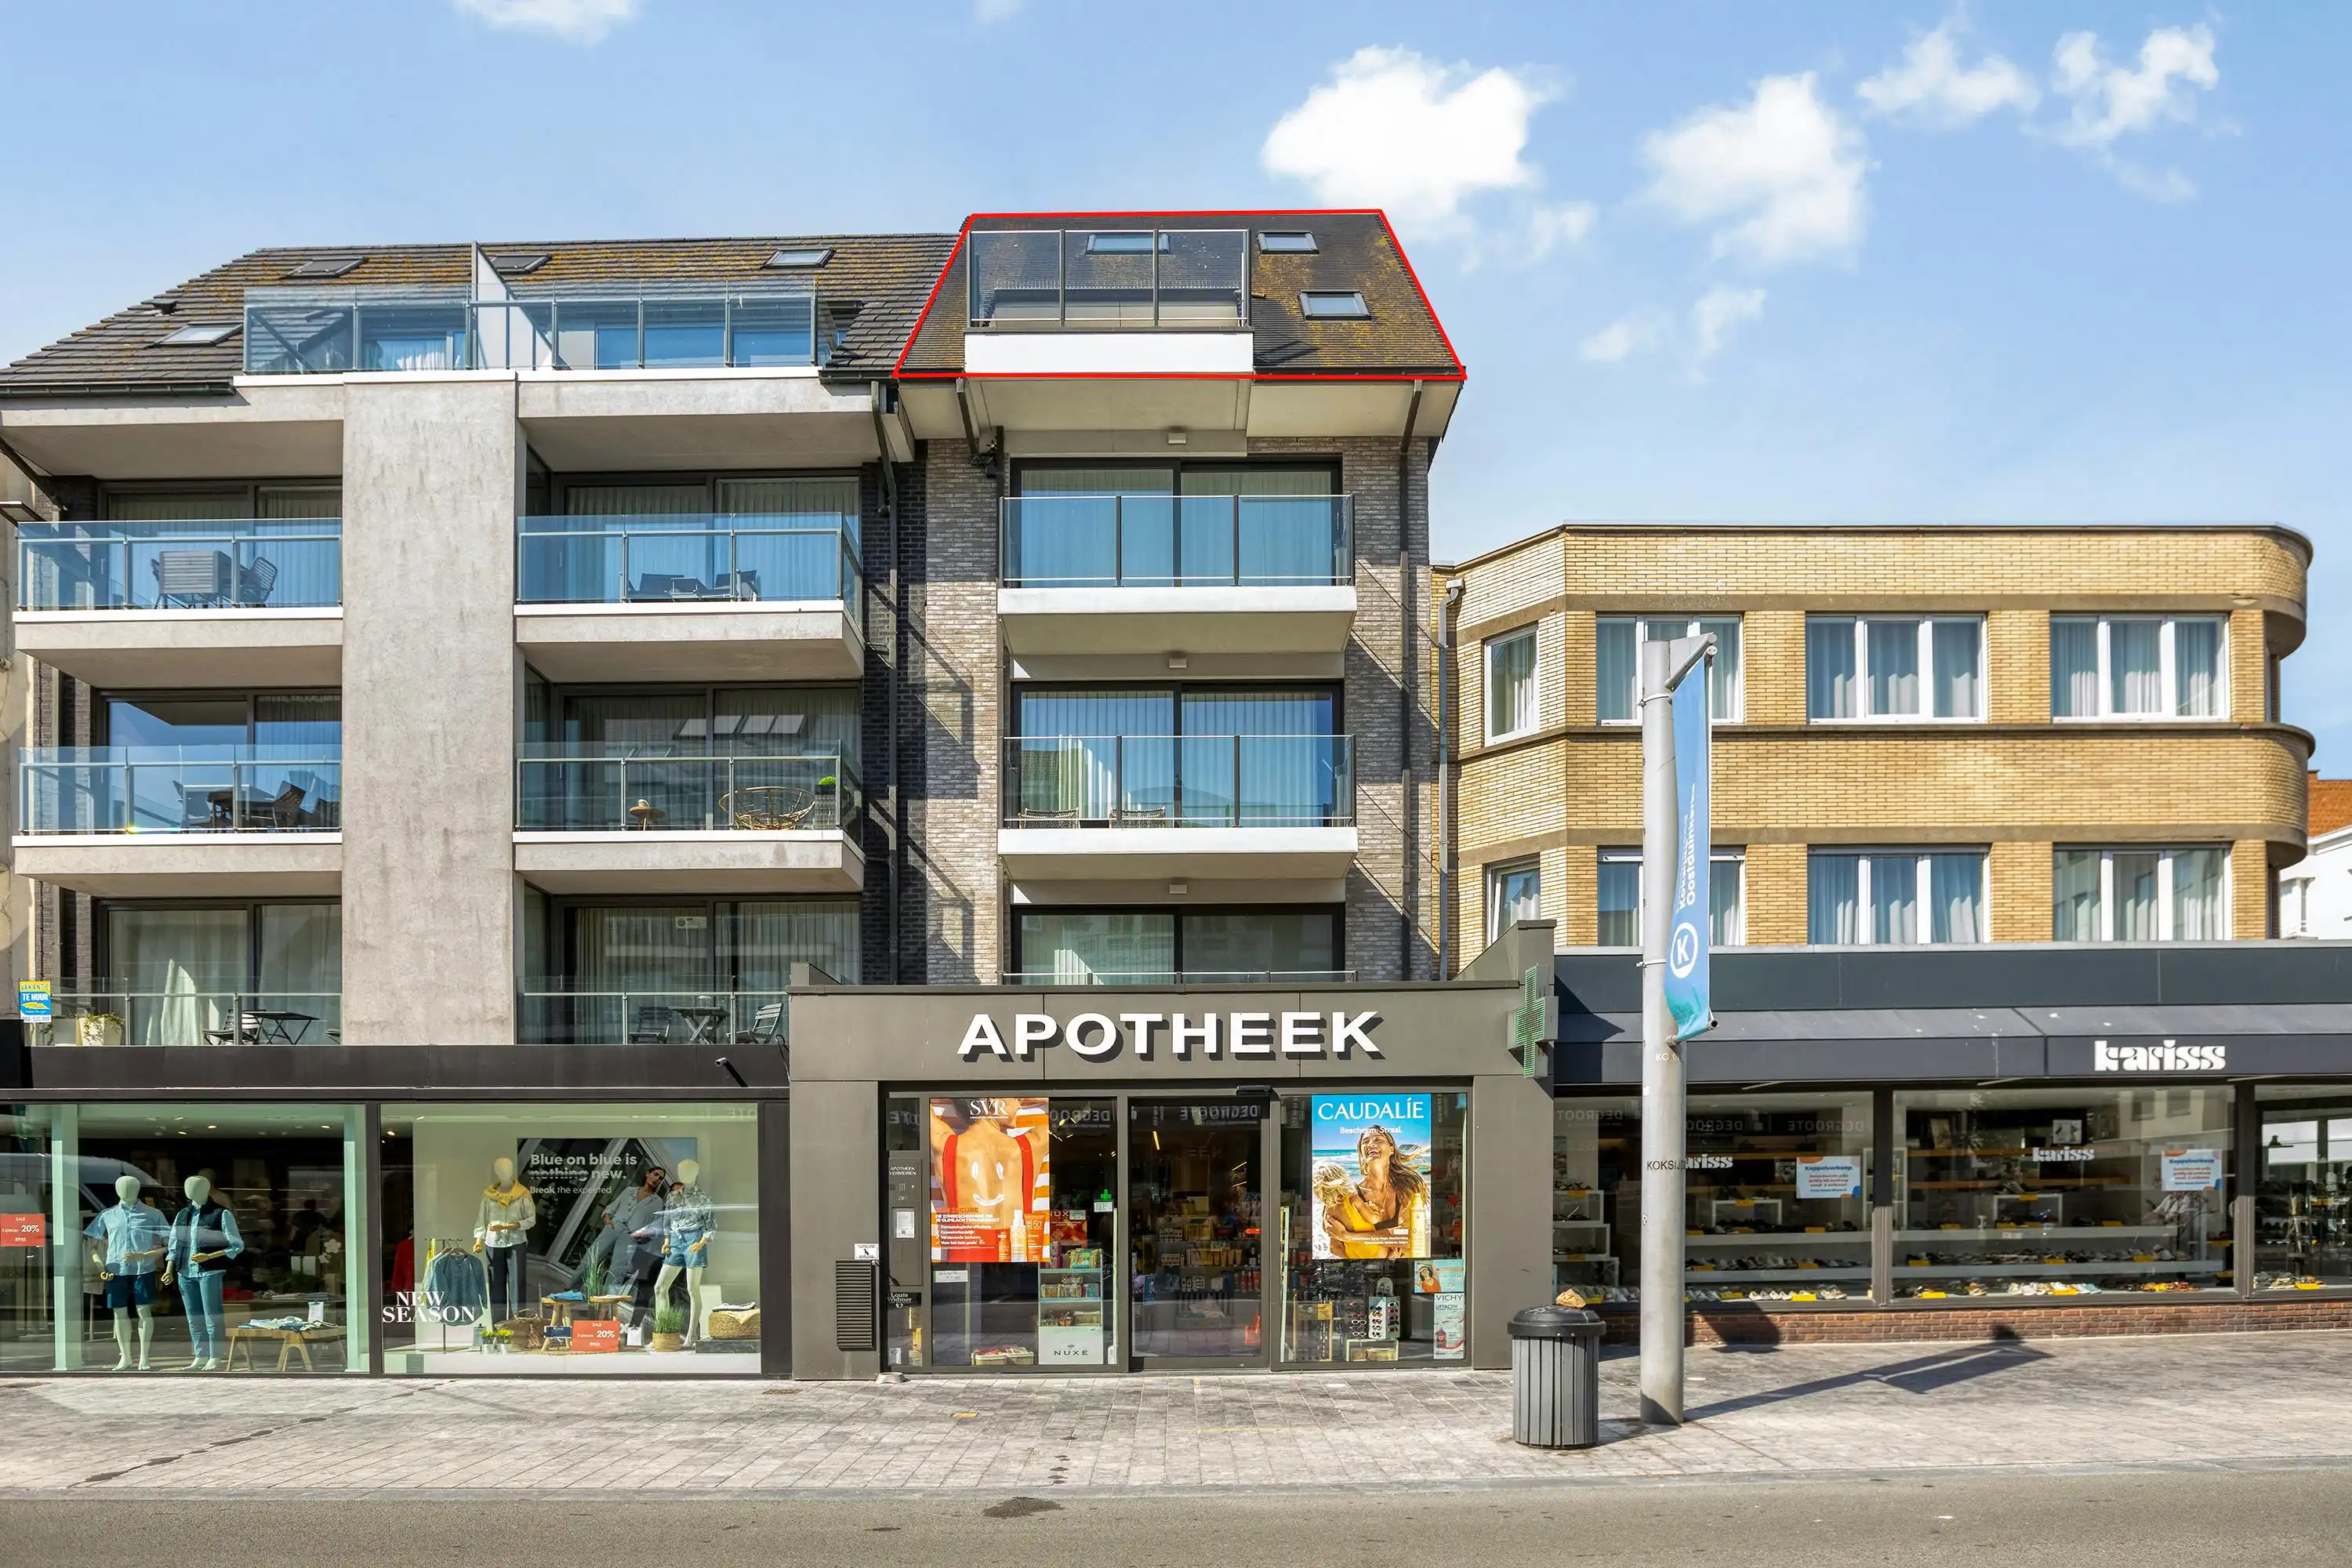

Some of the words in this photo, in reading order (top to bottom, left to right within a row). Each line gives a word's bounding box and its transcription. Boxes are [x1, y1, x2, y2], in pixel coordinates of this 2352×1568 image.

[22, 993, 30, 1001] TE
[31, 993, 49, 1001] HUUR
[956, 1011, 1381, 1055] APOTHEEK
[2094, 1040, 2227, 1072] kariss
[969, 1099, 1008, 1116] SVR
[1318, 1098, 1425, 1120] CAUDALÍE
[530, 1153, 563, 1165] Blue
[566, 1156, 586, 1165] on
[589, 1153, 622, 1165] blue
[626, 1153, 637, 1165] is
[1686, 1153, 1734, 1169] ariss
[2032, 1145, 2095, 1162] kariss
[591, 1170, 627, 1179] new.
[572, 1186, 612, 1196] expected
[395, 1291, 445, 1307] NEW
[382, 1306, 475, 1323] SEASON
[596, 1330, 615, 1338] 20%
